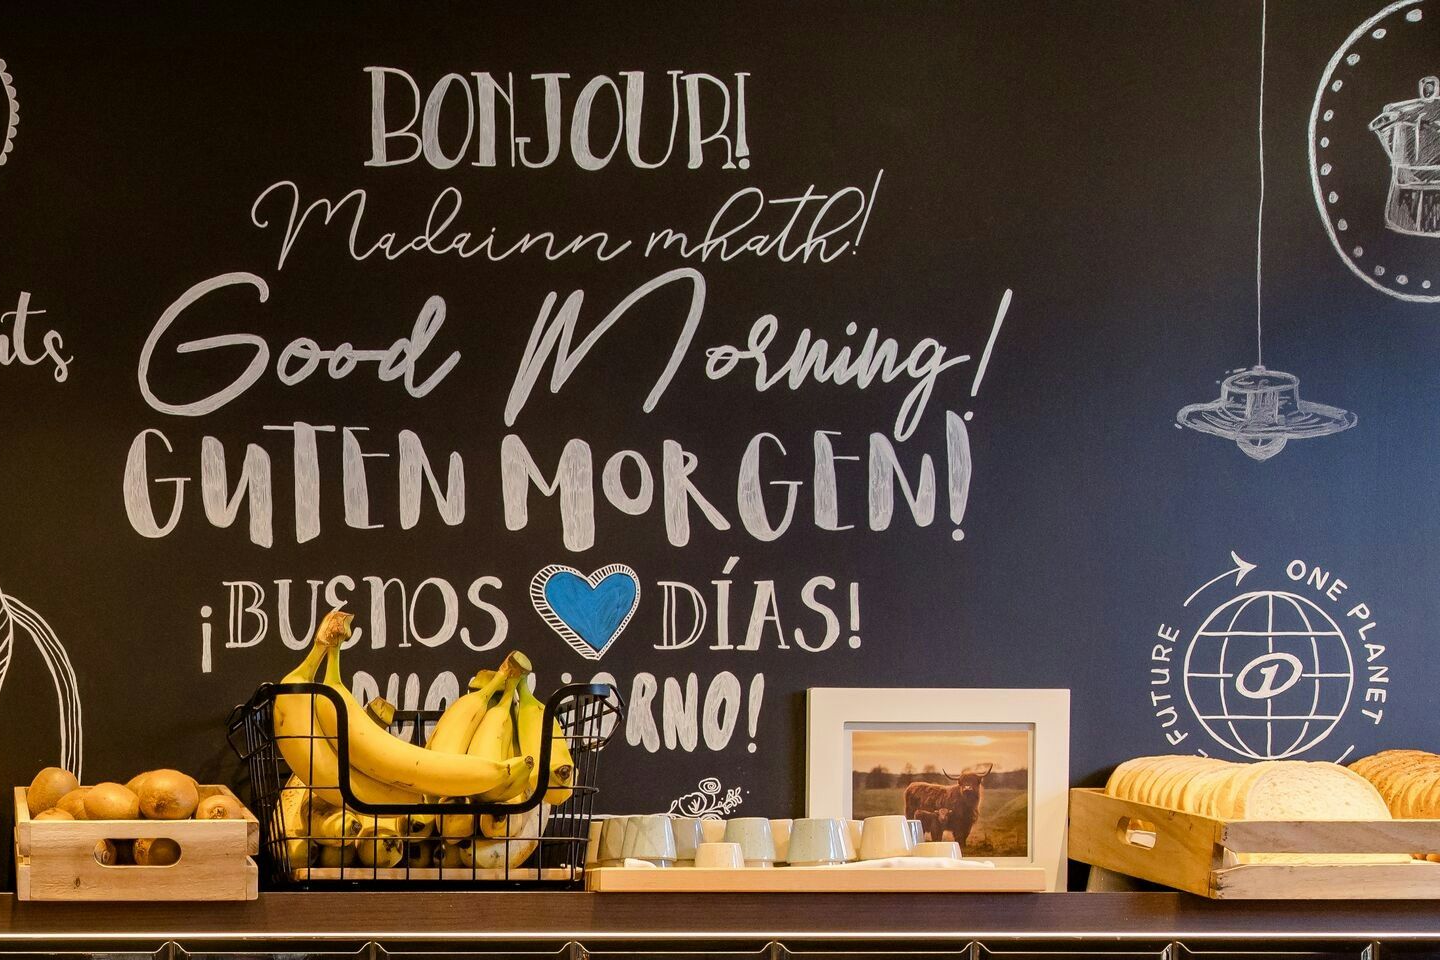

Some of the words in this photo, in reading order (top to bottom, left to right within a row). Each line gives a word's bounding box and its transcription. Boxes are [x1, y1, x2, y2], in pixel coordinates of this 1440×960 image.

[363, 66, 751, 171] BONJOUR!
[250, 179, 631, 271] Madainn
[645, 169, 884, 264] mhath!
[137, 271, 461, 417] Good
[504, 266, 1013, 441] Morning!
[122, 420, 465, 548] GUTEN
[501, 409, 972, 552] MORGEN!
[656, 555, 862, 651] DÍAS!
[1286, 559, 1348, 602] ONE
[1346, 603, 1390, 725] PLANET
[1150, 623, 1189, 746] FUTURE
